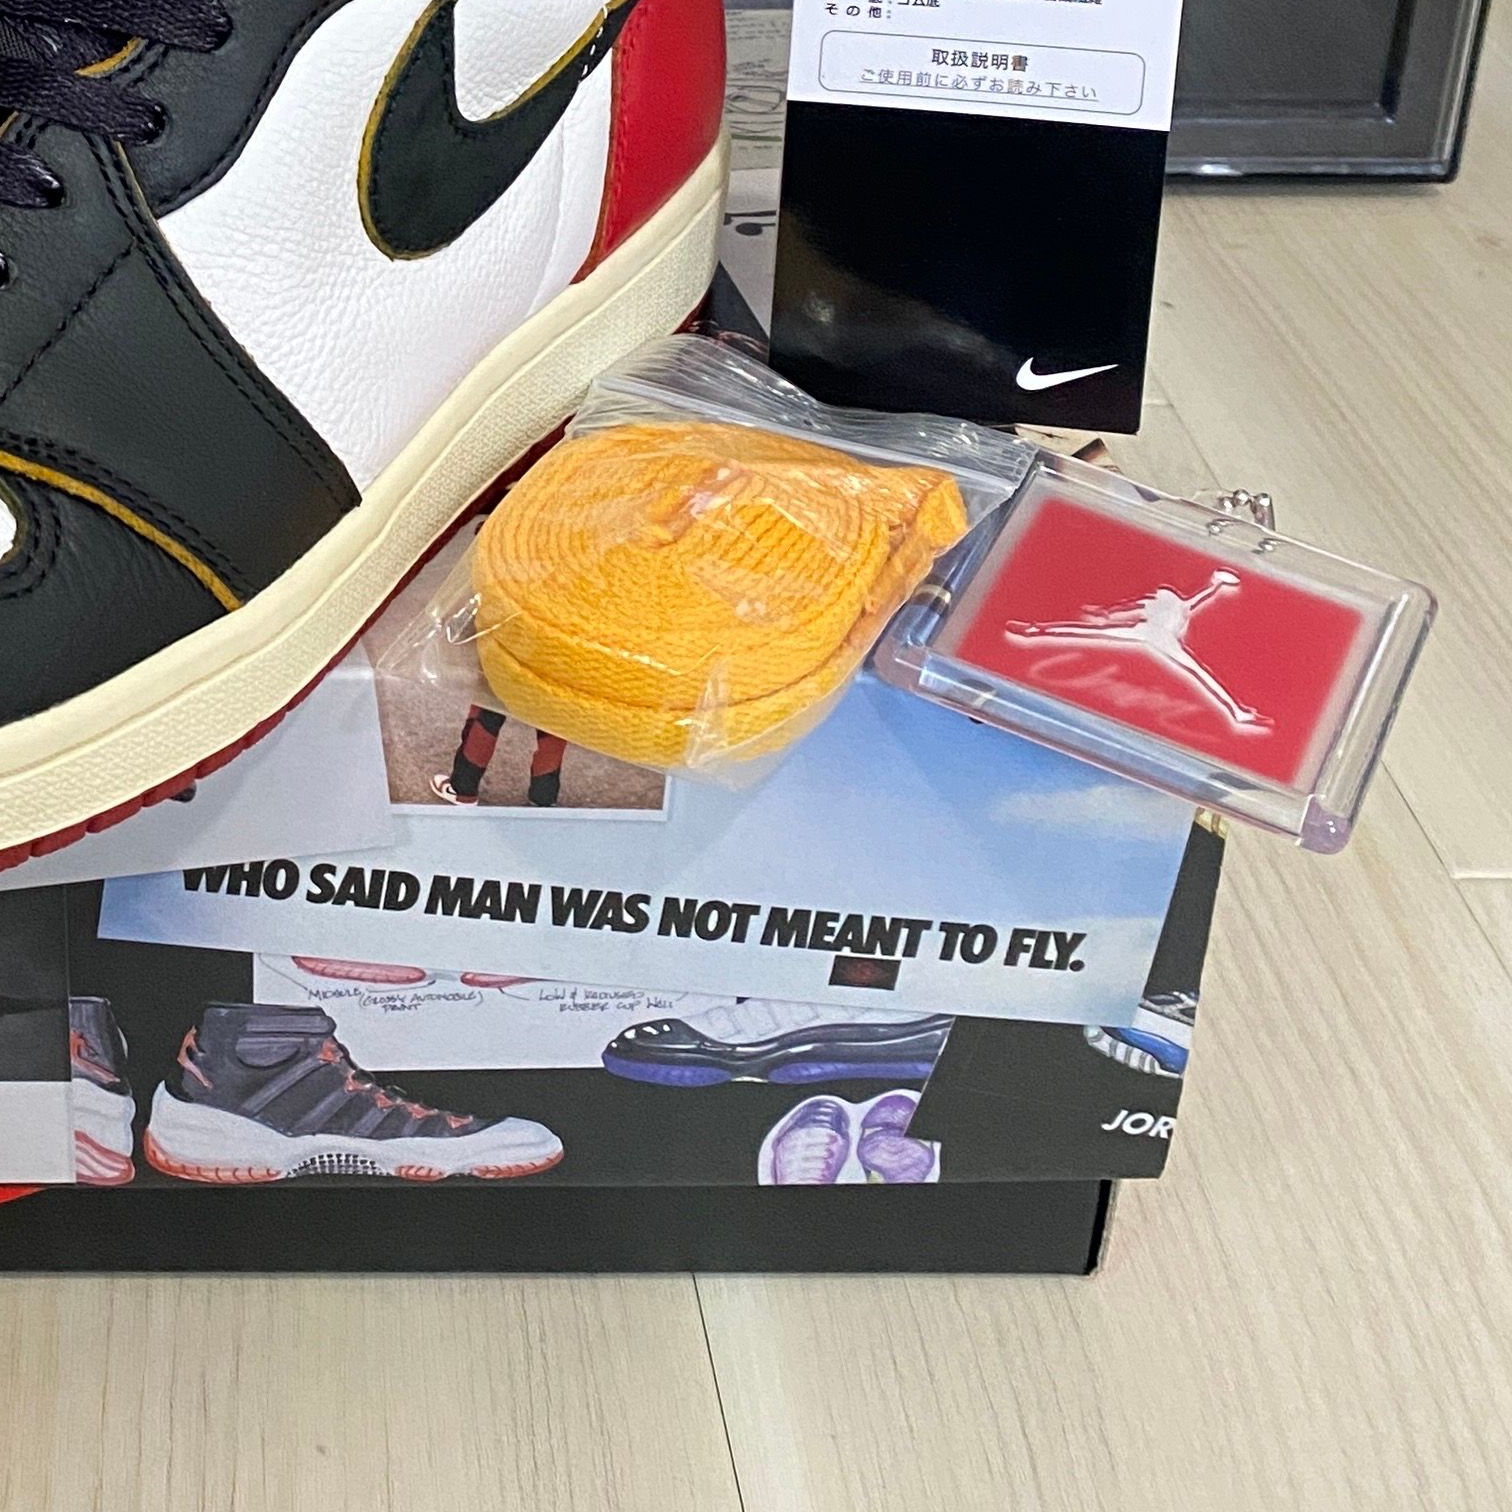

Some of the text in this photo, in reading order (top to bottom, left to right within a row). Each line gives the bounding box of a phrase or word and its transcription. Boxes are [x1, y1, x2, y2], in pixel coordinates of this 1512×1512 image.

[182, 858, 1088, 973] WHO SAID MAN WAS NOT MEANT TO FLY.
